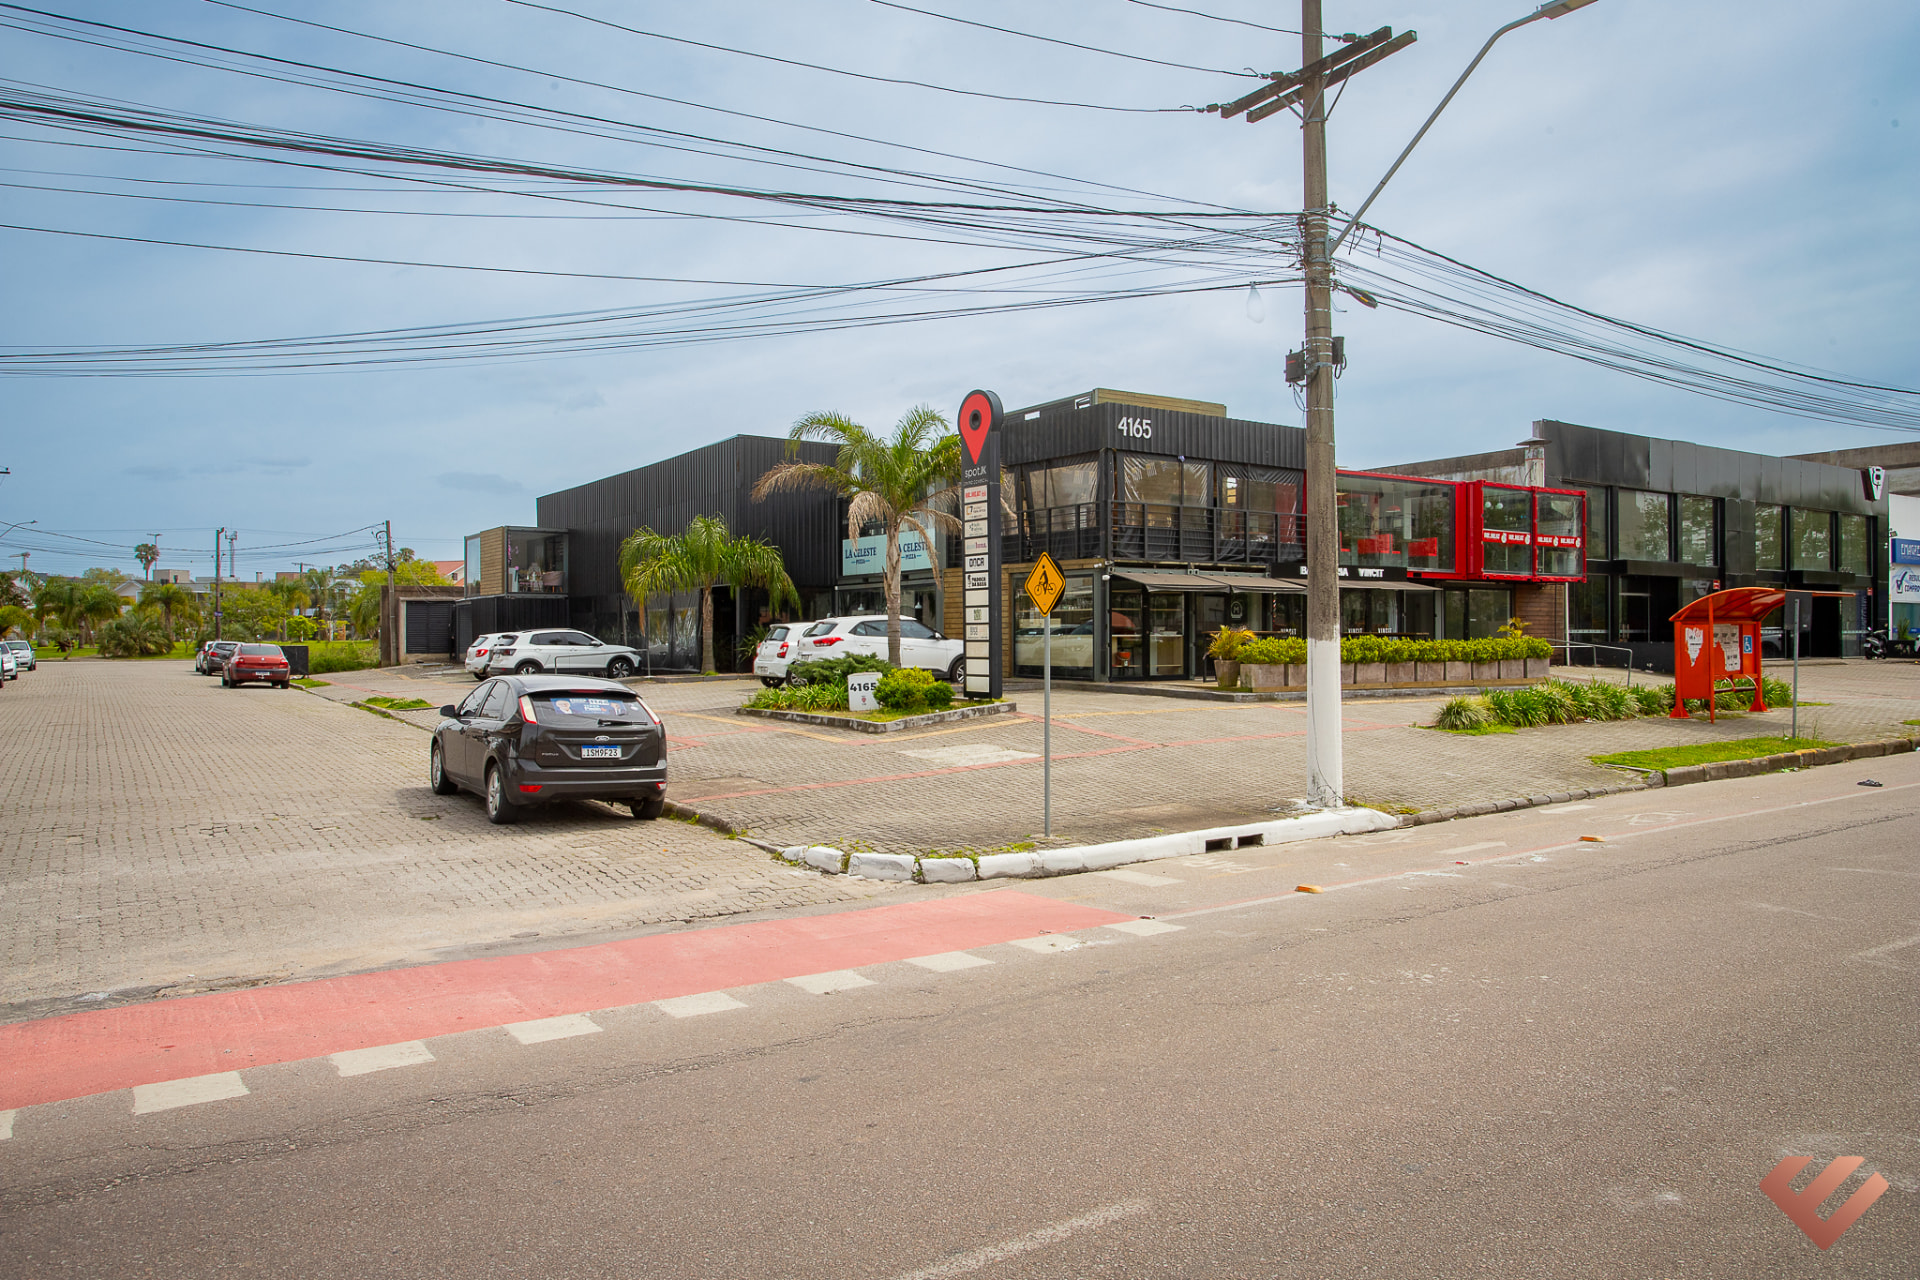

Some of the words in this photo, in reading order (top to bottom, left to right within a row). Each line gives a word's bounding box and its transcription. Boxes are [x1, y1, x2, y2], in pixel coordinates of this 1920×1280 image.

[1117, 416, 1152, 439] 4165
[845, 549, 852, 559] LA
[1358, 568, 1384, 578] VINCIT
[850, 682, 877, 692] 4165
[586, 749, 618, 757] ISM9F23
